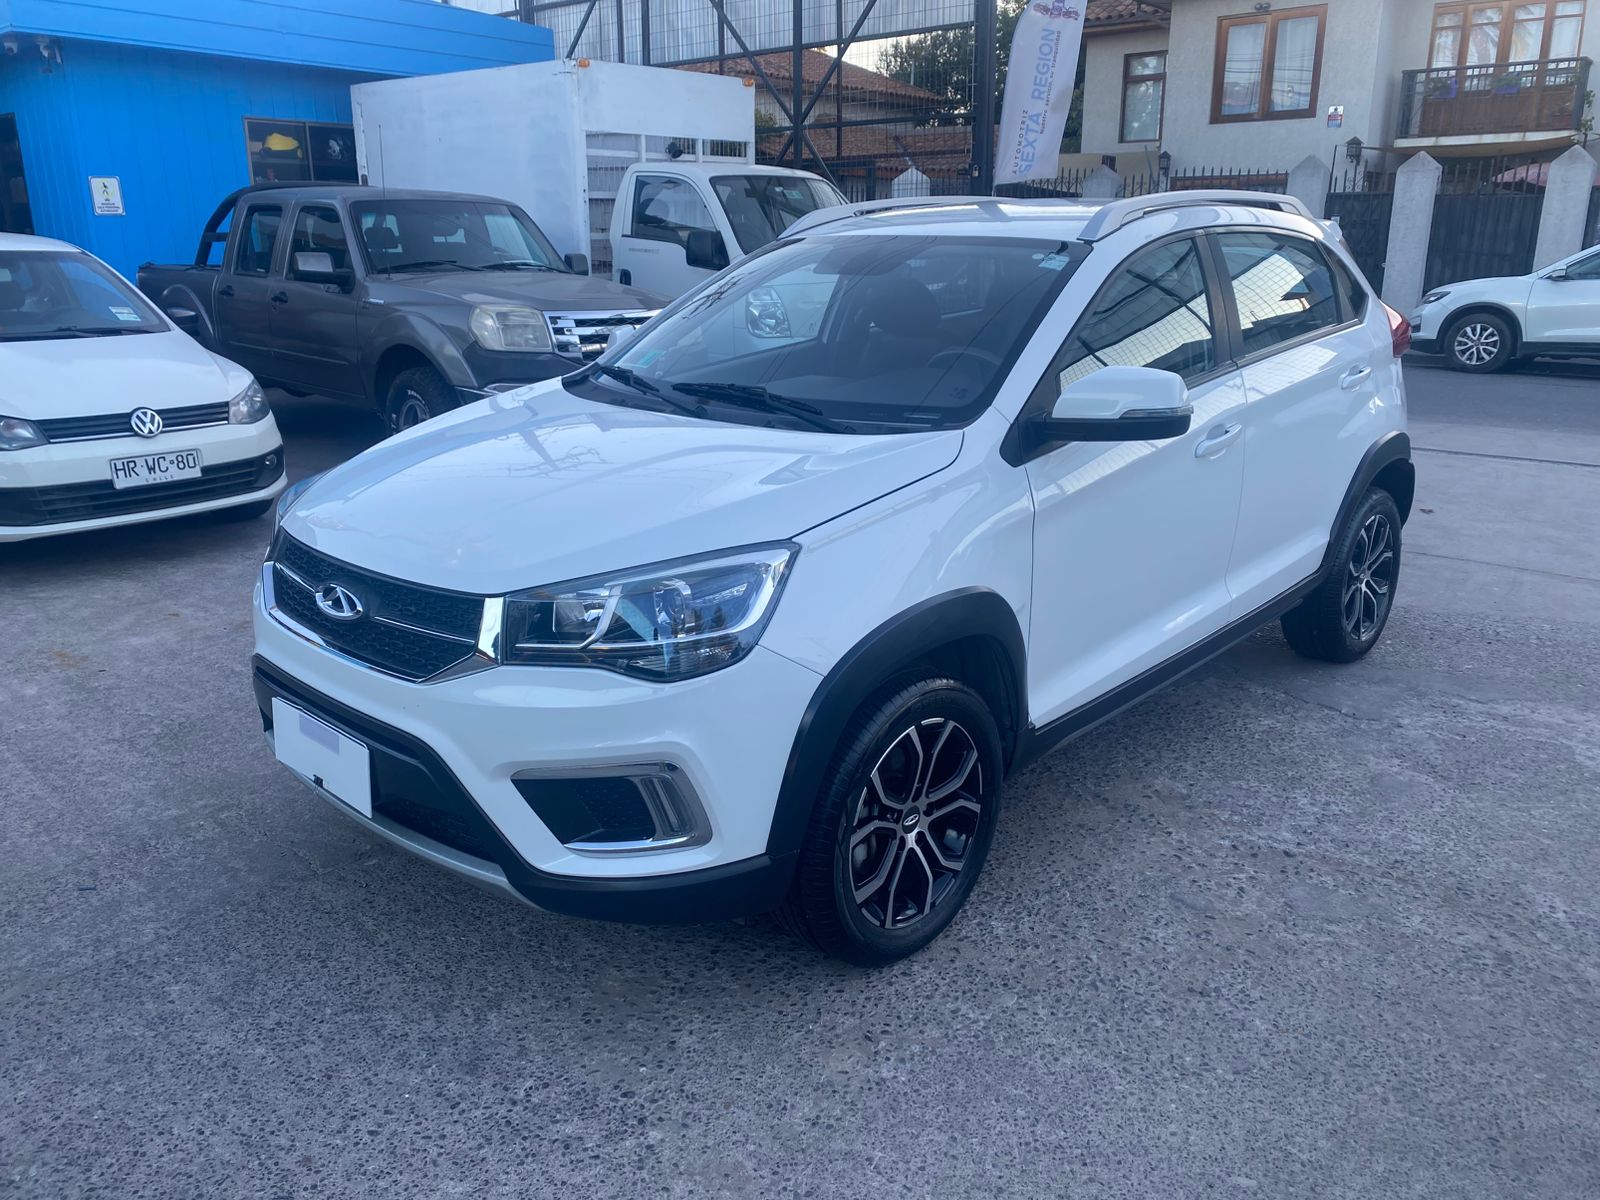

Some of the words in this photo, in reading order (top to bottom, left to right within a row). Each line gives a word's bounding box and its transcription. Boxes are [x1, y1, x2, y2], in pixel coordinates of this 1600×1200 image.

[1012, 109, 1029, 174] AUTOMOTRIZ
[1018, 112, 1042, 176] SEXTA
[1031, 28, 1056, 101] REGION
